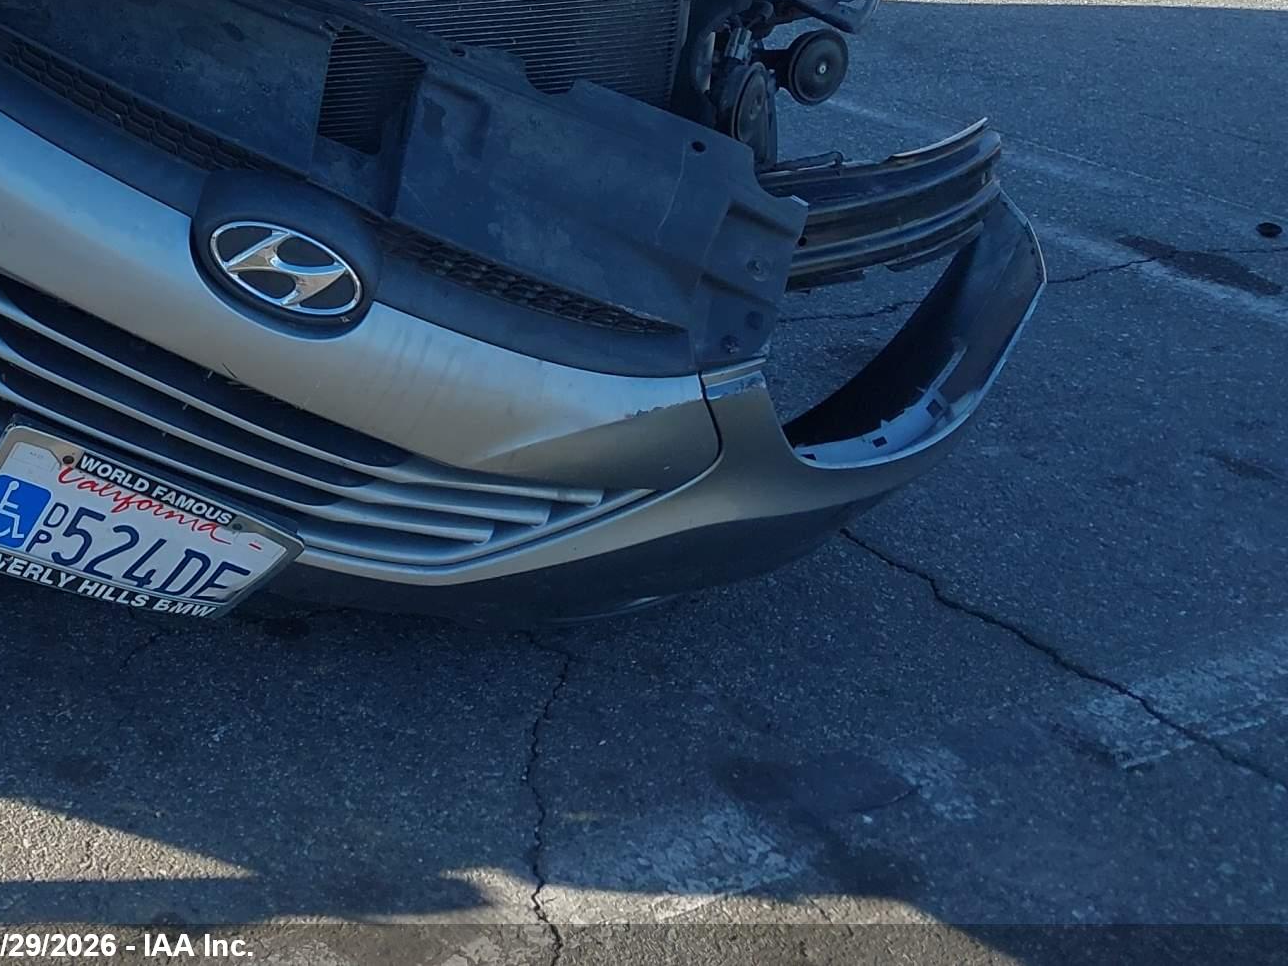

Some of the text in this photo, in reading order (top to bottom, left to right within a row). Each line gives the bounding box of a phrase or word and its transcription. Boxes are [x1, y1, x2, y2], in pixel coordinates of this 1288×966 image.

[58, 465, 232, 545] California
[81, 455, 232, 525] WORLD FAMOUS
[77, 578, 150, 608] HILLS
[153, 599, 217, 618] BMW
